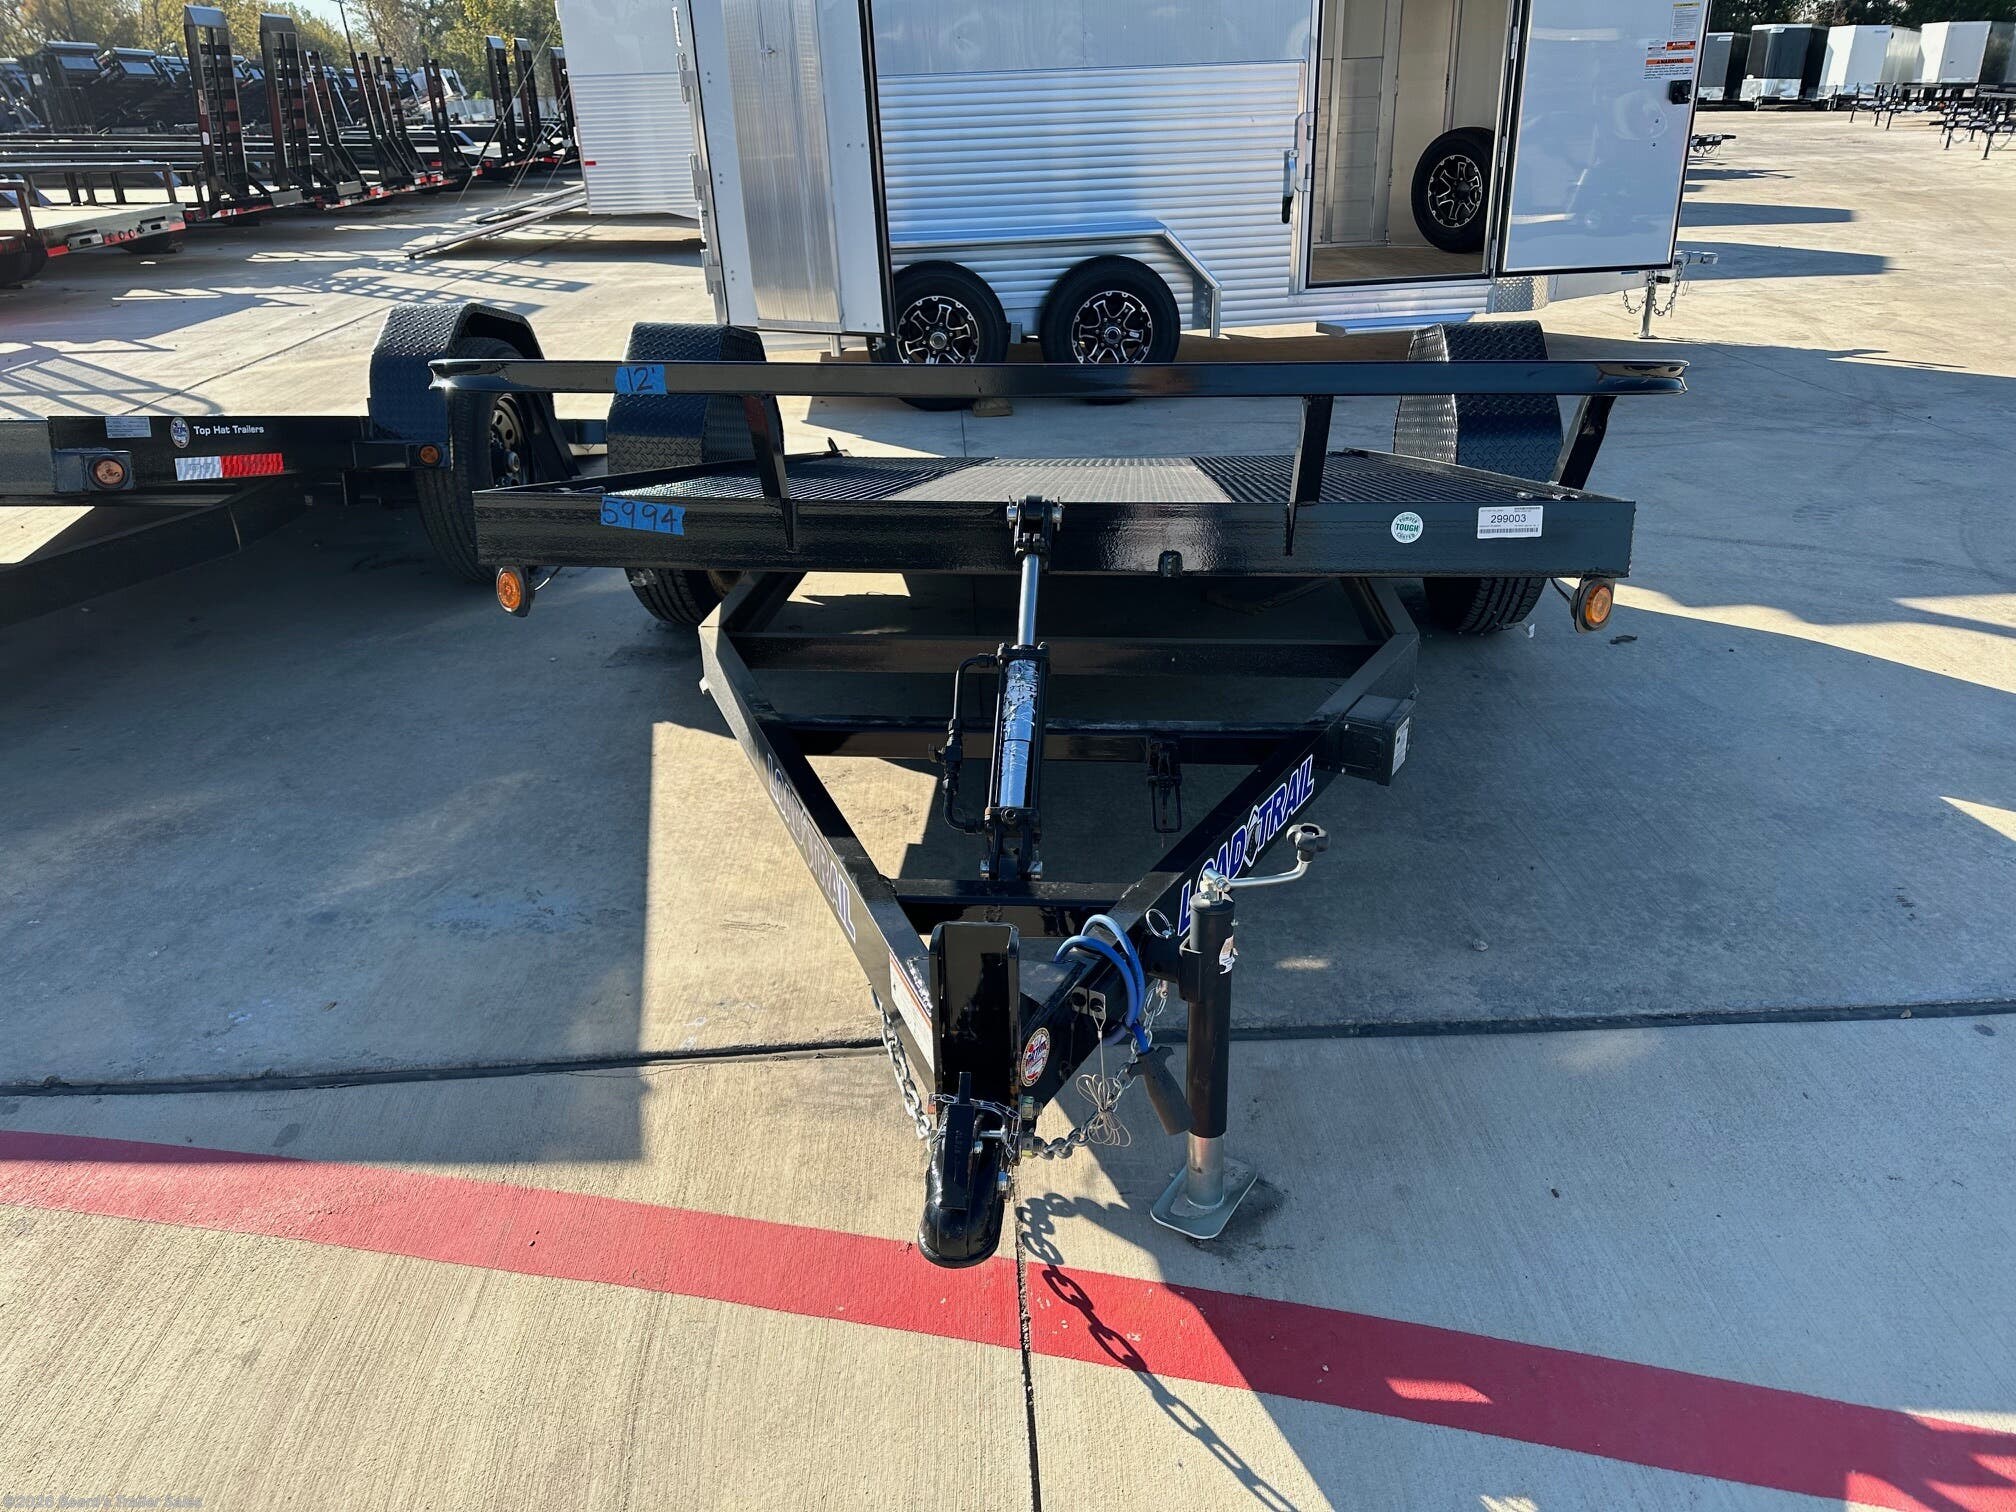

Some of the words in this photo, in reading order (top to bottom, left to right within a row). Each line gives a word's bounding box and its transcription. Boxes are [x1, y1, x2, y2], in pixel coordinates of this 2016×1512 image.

[626, 367, 656, 392] 12'
[193, 425, 211, 436] Top
[213, 425, 231, 435] Hat
[232, 424, 265, 434] Trailers
[601, 500, 679, 533] 5994
[1490, 513, 1527, 524] 299003
[1395, 523, 1419, 533] TOUGH
[1256, 753, 1316, 853] TRAIL
